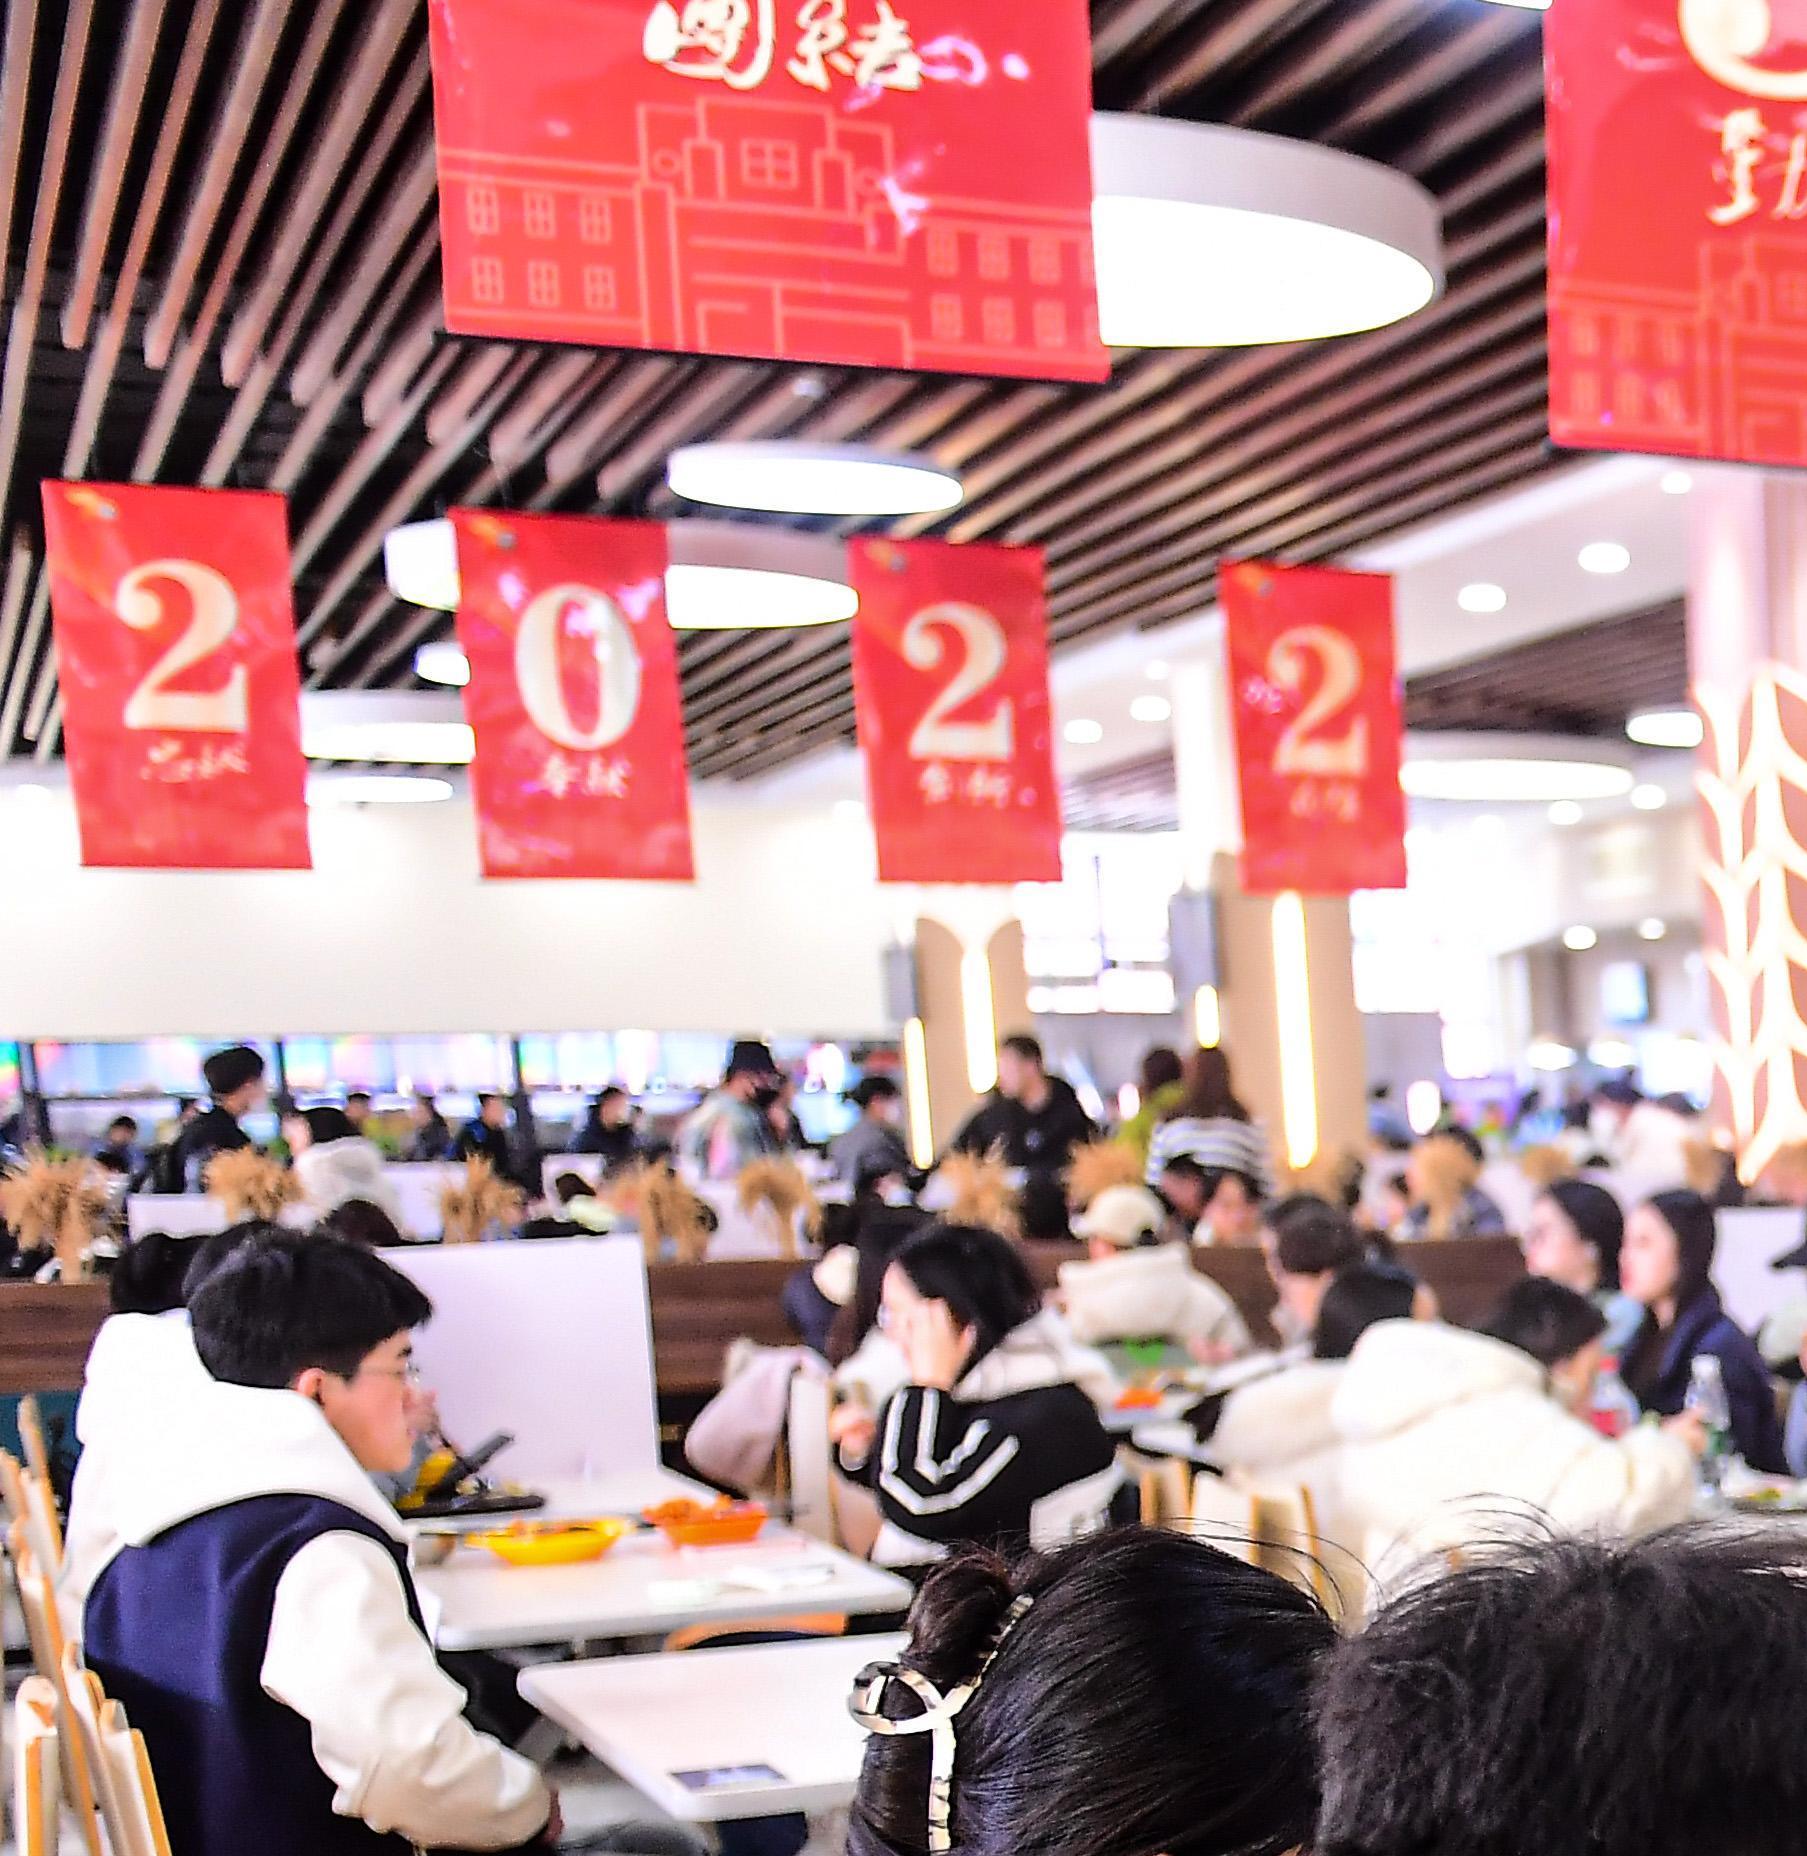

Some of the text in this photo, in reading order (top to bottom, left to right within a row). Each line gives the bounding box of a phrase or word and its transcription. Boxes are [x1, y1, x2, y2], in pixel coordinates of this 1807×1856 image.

[115, 558, 247, 732] 2
[515, 583, 642, 751] 0
[902, 602, 1014, 761] 2
[1266, 624, 1367, 776] 2
